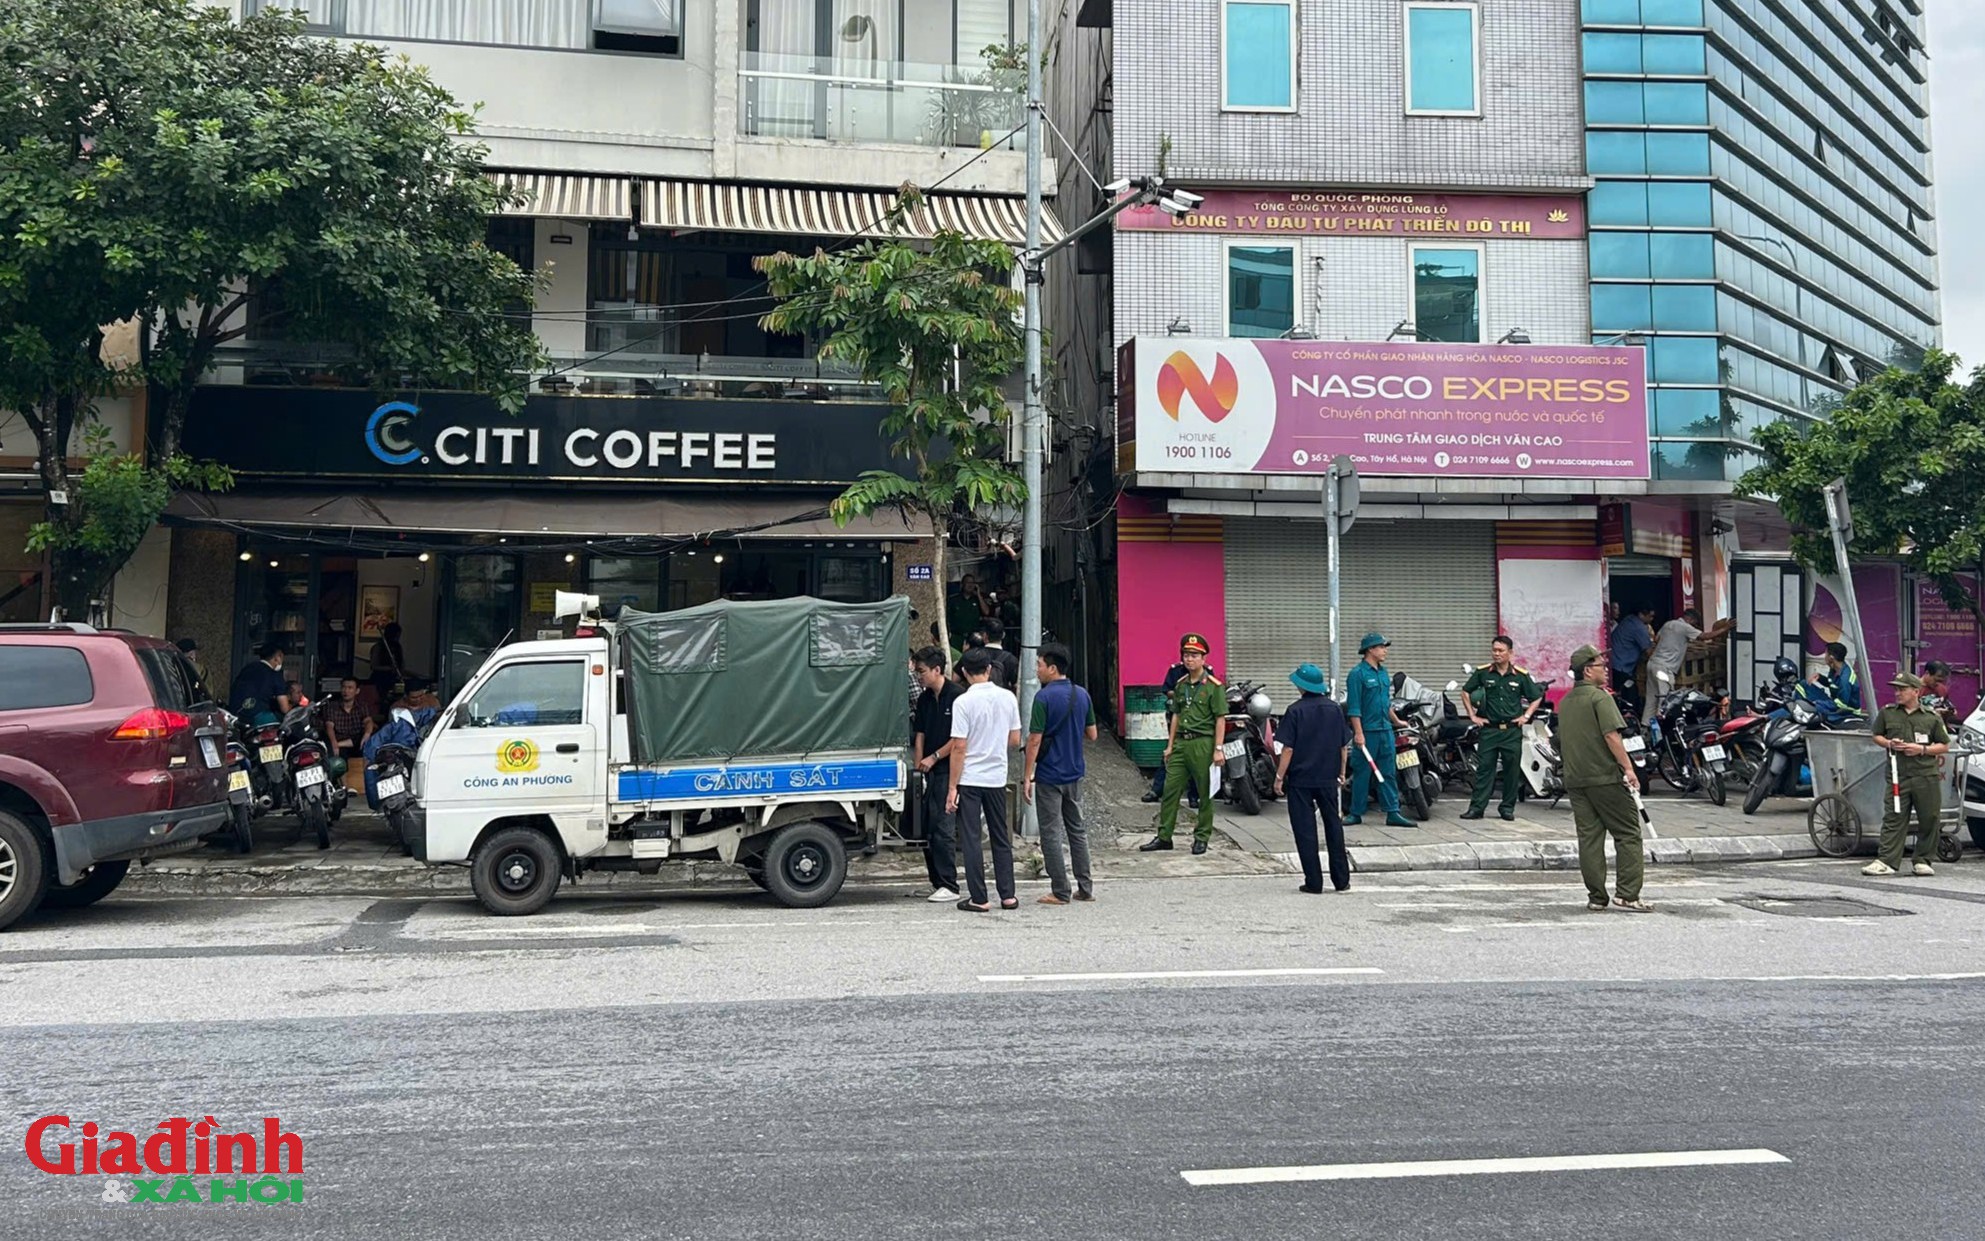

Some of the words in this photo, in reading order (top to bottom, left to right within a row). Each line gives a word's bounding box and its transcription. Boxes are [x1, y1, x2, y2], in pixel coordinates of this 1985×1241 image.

[1322, 204, 1337, 212] TY
[1235, 216, 1259, 228] TY
[1312, 216, 1340, 230] TƯ
[1466, 217, 1493, 232] ĐÔ
[1500, 220, 1531, 235] THỊ
[1324, 351, 1334, 360] TY
[1380, 352, 1405, 361] GIAO
[1489, 354, 1522, 363] NASCO
[1531, 355, 1564, 364] NASCO
[1566, 356, 1610, 365] LOGISTICS
[1612, 357, 1628, 365] JSC
[1292, 374, 1433, 400] NASCO
[1443, 377, 1631, 403] EXPRESS
[1375, 408, 1407, 421] phát
[1411, 409, 1453, 420] nhanh
[1456, 409, 1491, 423] trong
[1533, 410, 1549, 422] và
[1553, 409, 1587, 425] quốc
[1591, 410, 1605, 423] tế
[1179, 433, 1216, 442] HOTLINE
[1364, 433, 1403, 444] TRUNG
[1406, 432, 1432, 444] TÂM
[1435, 434, 1468, 445] GIAO
[1471, 433, 1500, 447] DỊCH
[1504, 434, 1530, 446] VĂN
[1533, 435, 1562, 446] CAO
[435, 426, 540, 466] CITI
[564, 427, 776, 469] COFFEE
[1165, 446, 1196, 458] 1900
[1201, 447, 1232, 459] 1106
[1371, 454, 1384, 465] Tây
[1452, 456, 1468, 464] 024
[1470, 456, 1489, 464] 7109
[1490, 457, 1510, 465] 6666
[1535, 458, 1634, 469] www.nascoexpress.com
[463, 776, 499, 788] CÔNG
[502, 778, 519, 787] AN
[694, 767, 774, 792] CẢNH
[789, 765, 843, 787] SÁT
